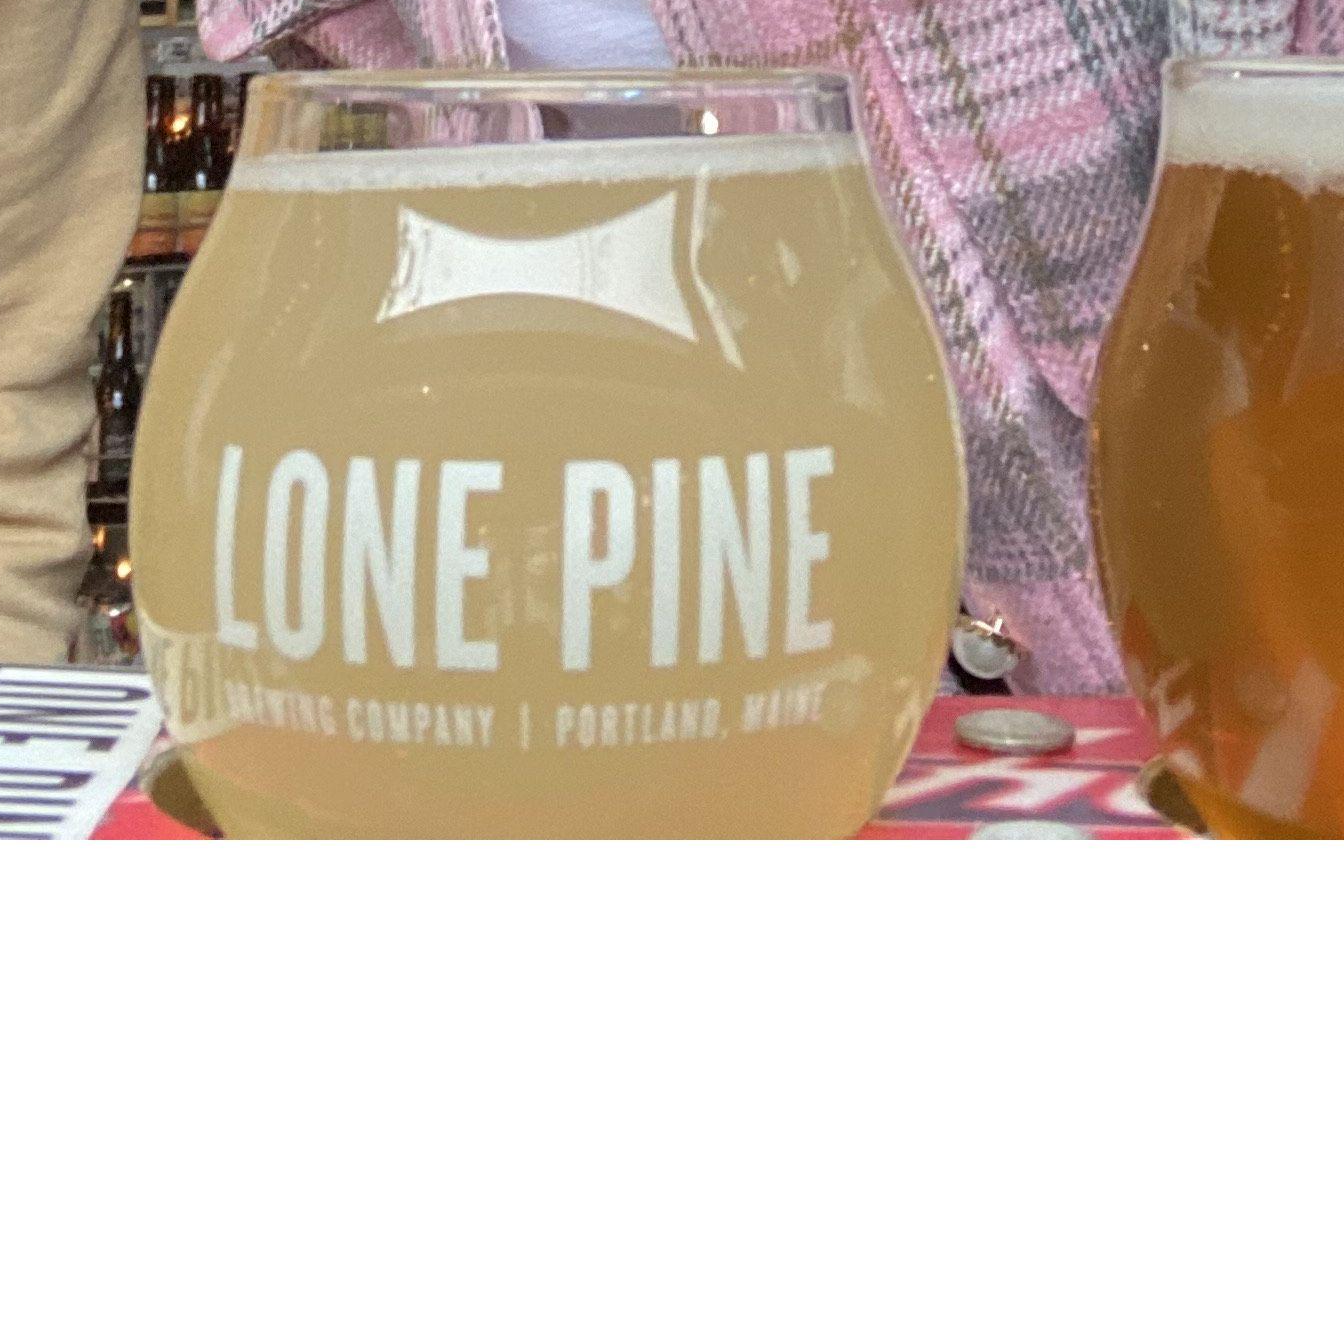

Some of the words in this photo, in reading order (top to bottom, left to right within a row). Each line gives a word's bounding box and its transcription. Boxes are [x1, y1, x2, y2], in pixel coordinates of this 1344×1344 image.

[213, 443, 503, 672] LONE
[560, 446, 835, 672] PINE
[346, 697, 495, 748] COMPANY
